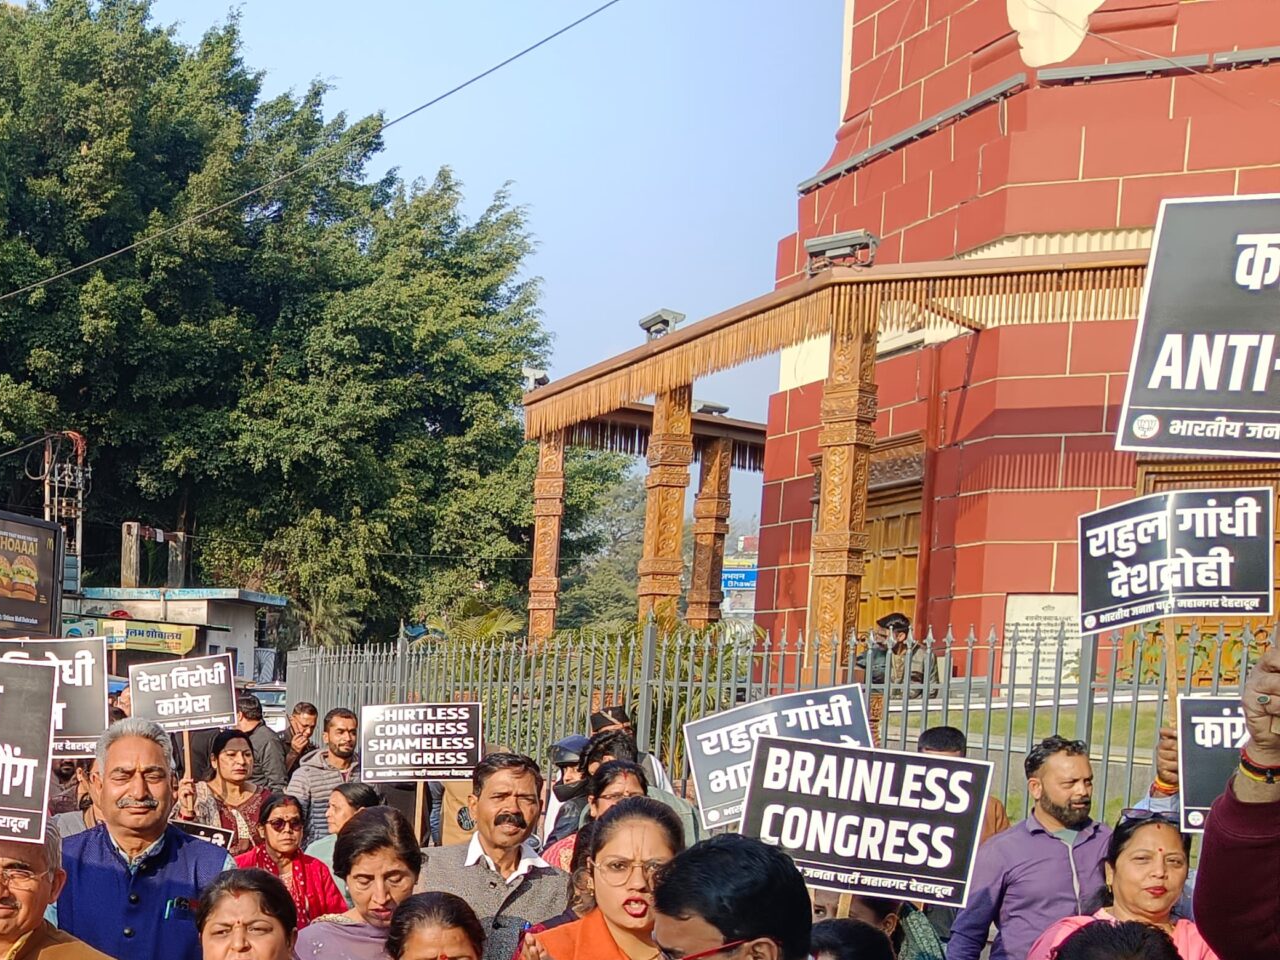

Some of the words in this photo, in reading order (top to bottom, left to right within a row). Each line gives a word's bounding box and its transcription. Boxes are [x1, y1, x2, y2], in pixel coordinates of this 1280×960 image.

[1169, 416, 1245, 438] भारतीय
[1086, 509, 1169, 558] राहुल
[1175, 496, 1262, 538] गांधी
[1107, 547, 1235, 598] देशद्रोही
[1099, 607, 1130, 624] भारतीय
[136, 671, 168, 693] देश
[169, 661, 227, 689] विरोधी
[155, 692, 212, 717] कांग्रेस
[375, 722, 469, 737] CONGRESS
[696, 712, 778, 756] राहुल
[780, 693, 853, 733] गांधी
[368, 737, 475, 752] SHAMELESS
[374, 752, 469, 766] CONGRESS
[762, 747, 974, 814] BRAINLESS
[760, 803, 956, 870] CONGRESS
[803, 867, 836, 882] जनता
[836, 870, 860, 886] पार्टी
[861, 874, 908, 891] महानगर
[909, 879, 954, 898] देहरादून
